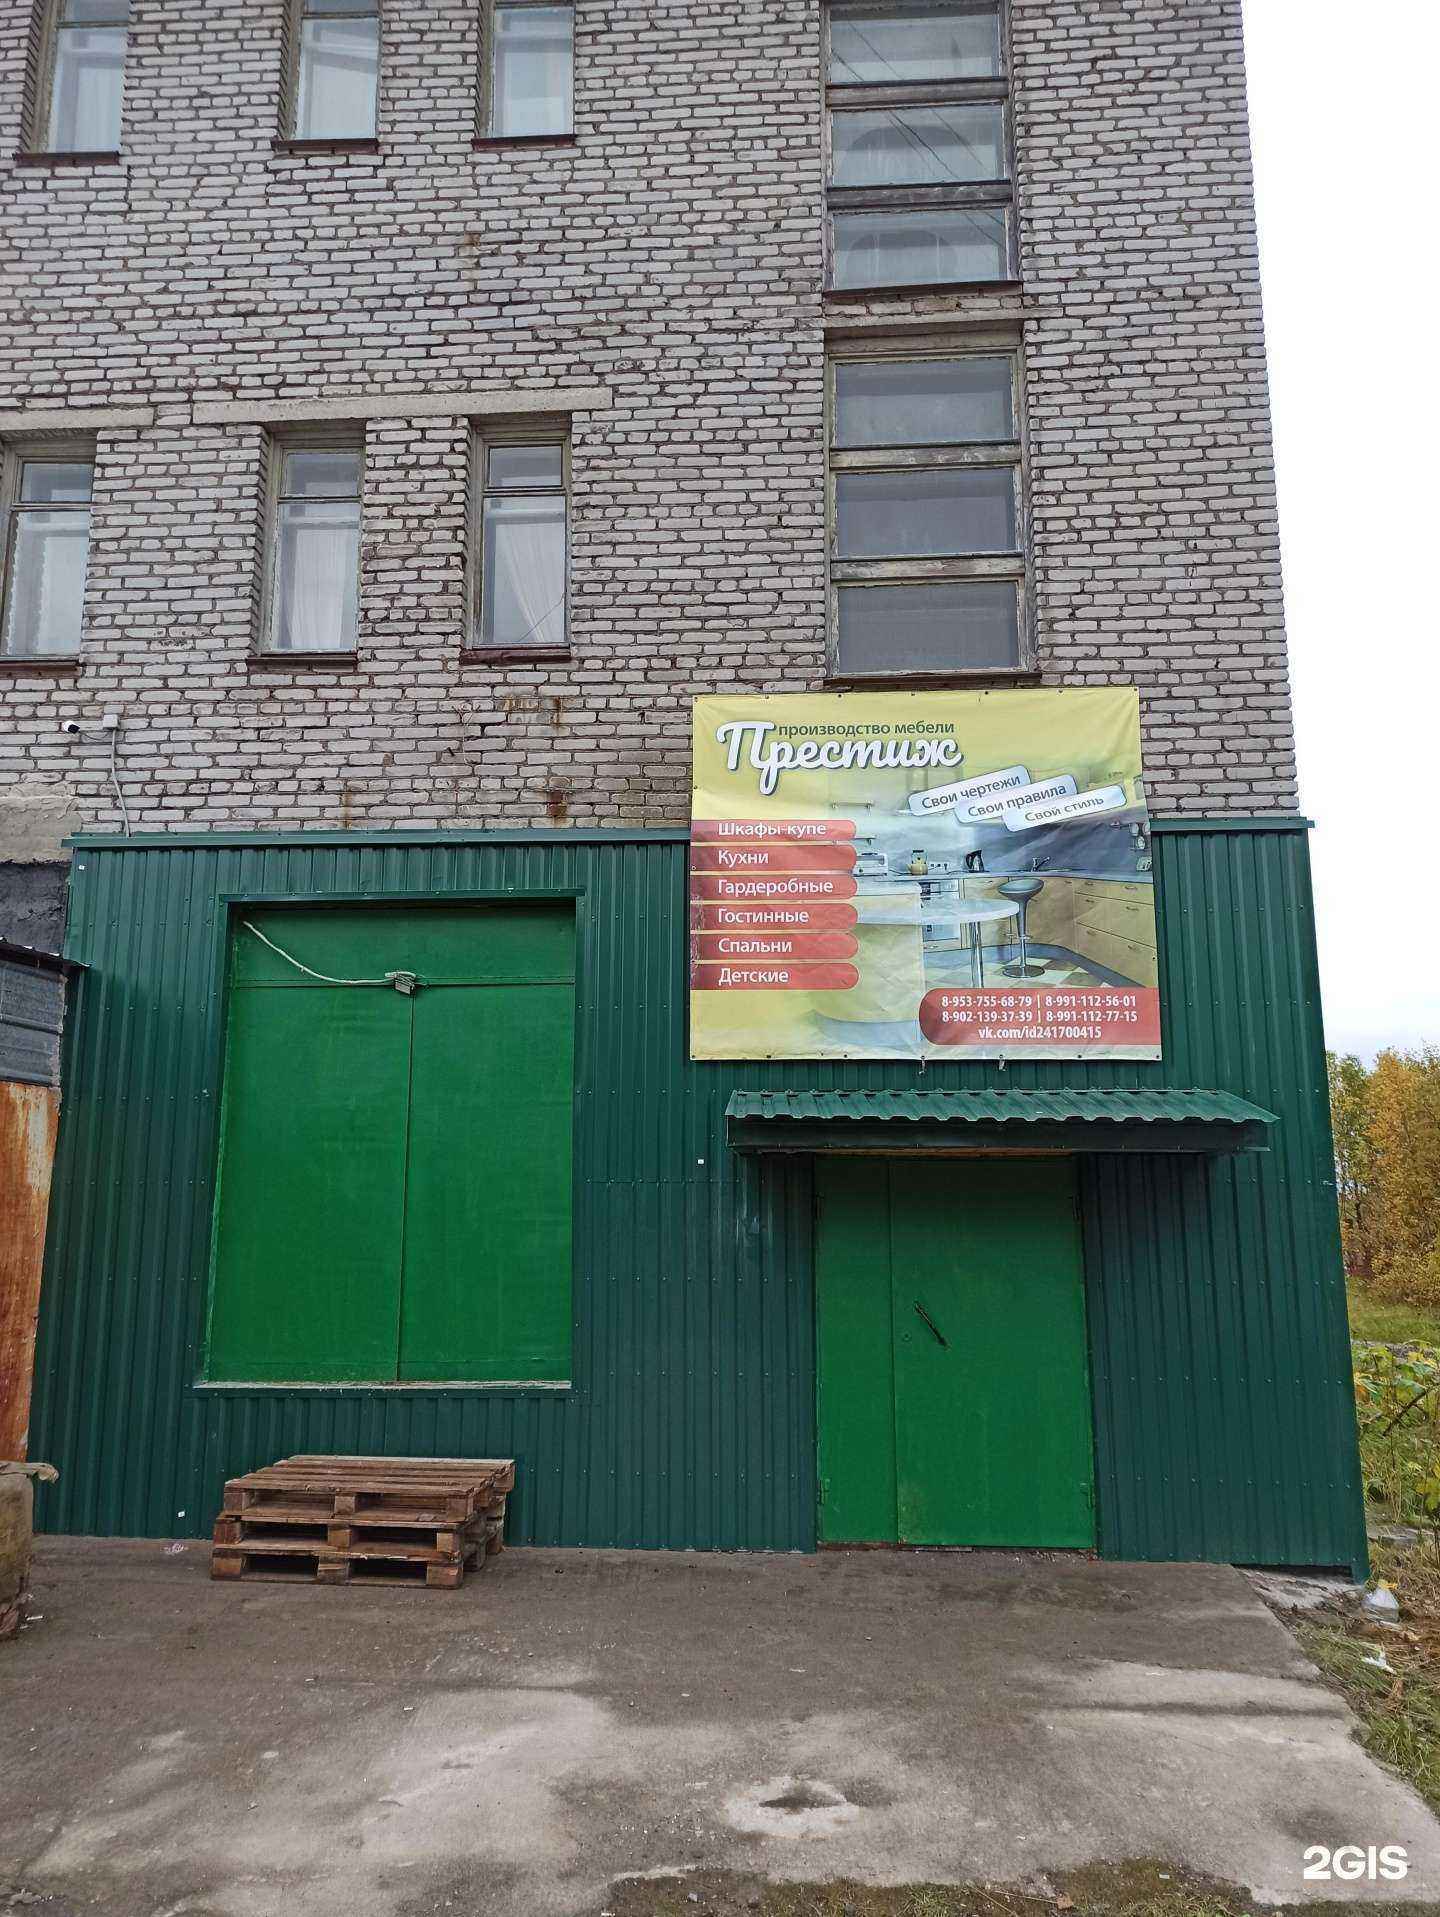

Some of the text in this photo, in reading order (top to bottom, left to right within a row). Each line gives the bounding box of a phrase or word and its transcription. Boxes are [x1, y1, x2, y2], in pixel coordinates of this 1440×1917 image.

[778, 720, 955, 739] производство мебели
[716, 720, 965, 796] Престиж
[921, 775, 1021, 810] Свои чертежи
[968, 785, 1067, 818] Свои правила
[1024, 796, 1104, 823] Свой стиль
[718, 822, 827, 839] Шкафы-купе
[718, 849, 769, 868] Кухни
[718, 877, 834, 897] Гардеробные
[718, 907, 810, 923] Гостинные
[718, 937, 793, 953] Спальни
[718, 967, 790, 986] Детские
[941, 995, 1137, 1008] 8-953-755-68-79 8-991-112-56-01
[942, 1010, 1138, 1023] 8-902-139-37-39 8-991-112-77-15
[978, 1026, 1102, 1040] vk.com/id241700415
